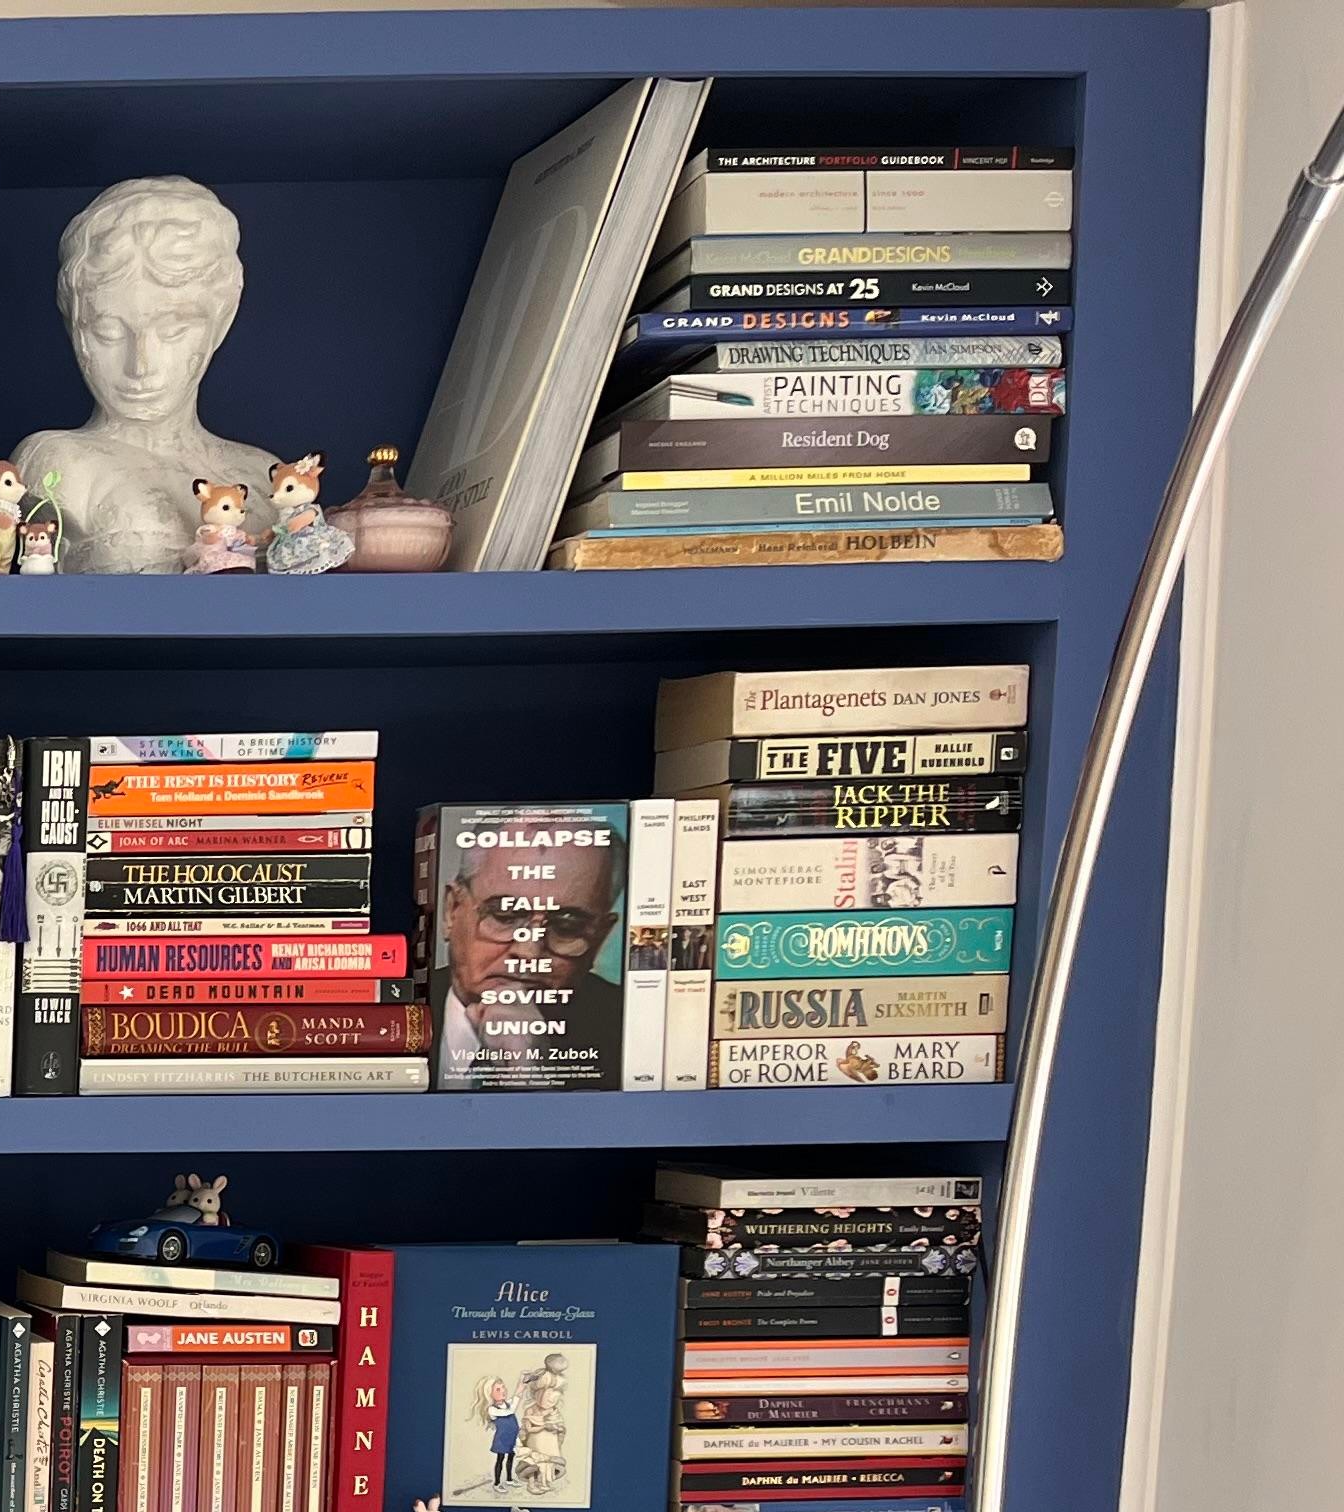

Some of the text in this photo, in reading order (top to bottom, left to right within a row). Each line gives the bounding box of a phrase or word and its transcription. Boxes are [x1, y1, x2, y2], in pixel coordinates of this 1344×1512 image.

[710, 278, 879, 299] GRAND DESIGNS AT 25
[782, 431, 890, 451] Resident Dog
[795, 491, 941, 515] Emil Nolde
[768, 742, 907, 776] THE FIVE
[456, 830, 611, 848] COLLAPSE
[123, 863, 307, 884] THE HOLOCAUST
[124, 885, 306, 905] MARTIN GILBERT
[893, 1041, 960, 1060] MARY
[888, 1060, 964, 1081] BEARD
[746, 1223, 893, 1235] WUTHERING HEIGHTS
[494, 1281, 551, 1304] Alice
[176, 1330, 286, 1345] JANE AUSTEN
[472, 1330, 573, 1340] LEWIS CARROLL
